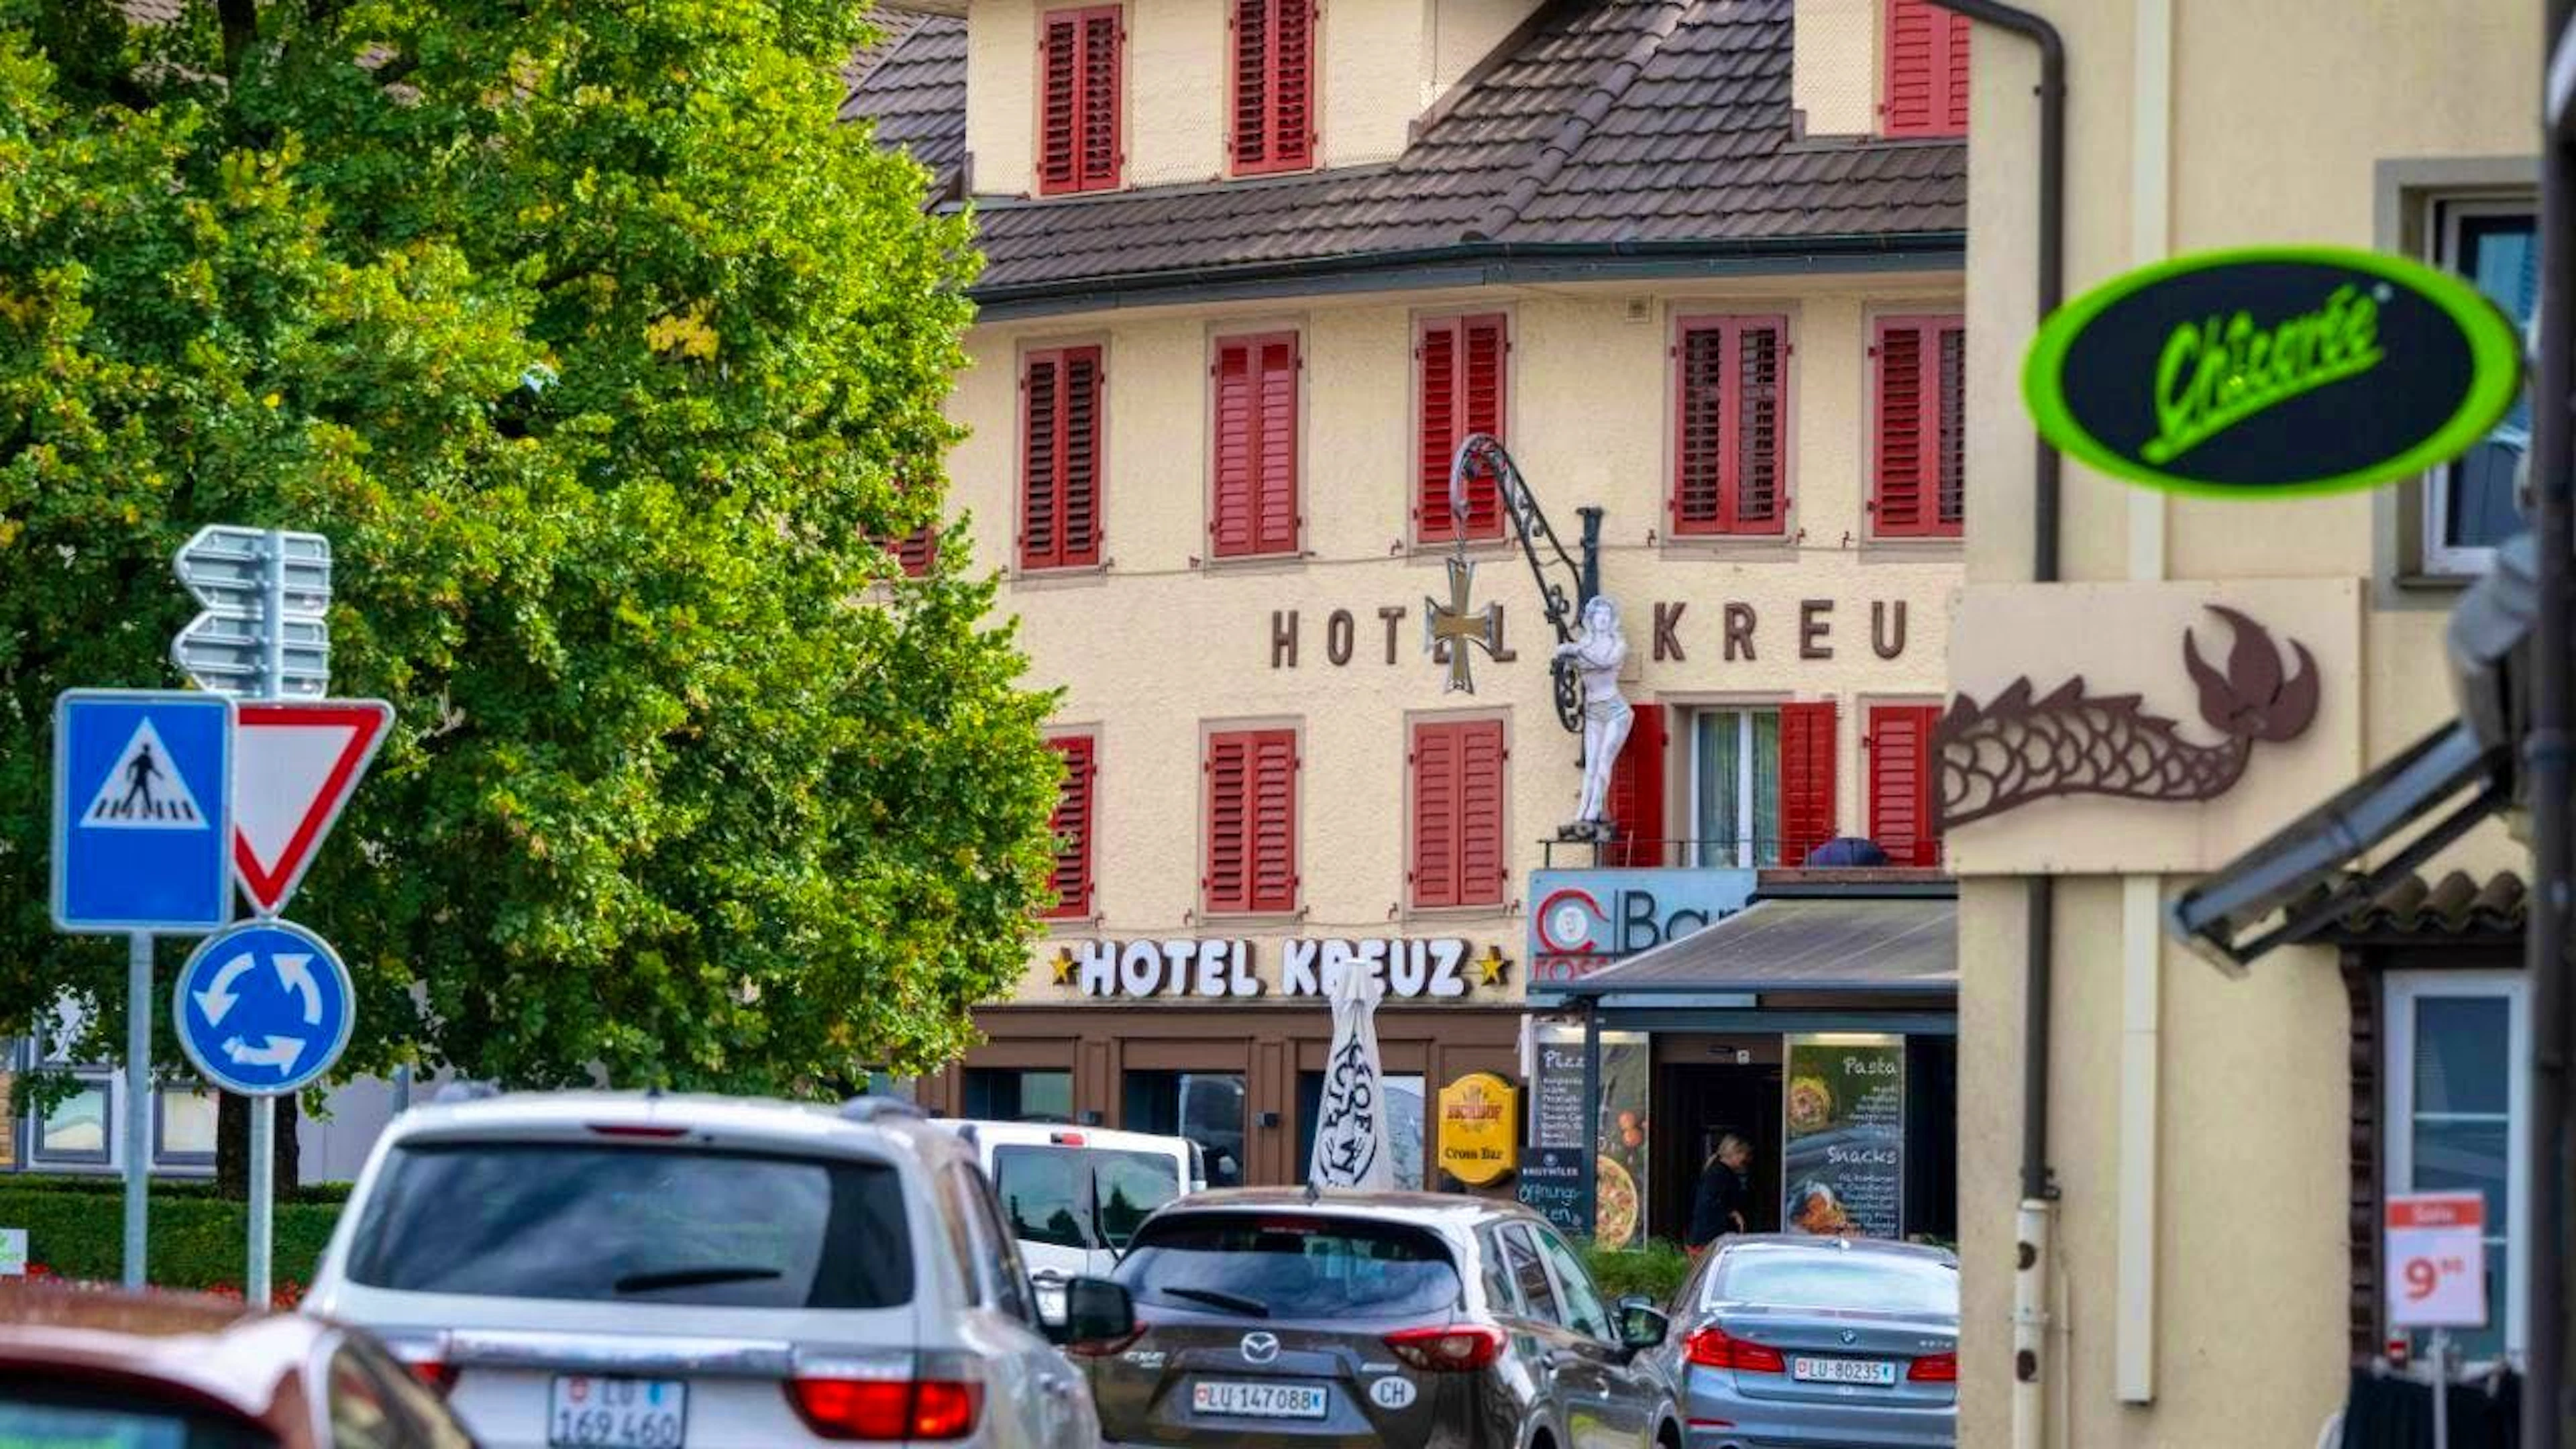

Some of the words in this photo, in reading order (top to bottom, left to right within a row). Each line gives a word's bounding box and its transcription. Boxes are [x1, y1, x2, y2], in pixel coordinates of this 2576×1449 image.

[1272, 604, 1517, 668] HOTL
[1081, 939, 1263, 998] HOTEL
[1281, 939, 1465, 998] KREUZ
[1843, 1055, 1897, 1075] Pasta
[1481, 1147, 1503, 1160] Bar
[1826, 1144, 1898, 1165] Snacks
[602, 1379, 636, 1406] LU
[1209, 1386, 1232, 1407] LU
[1380, 1382, 1405, 1403] CH
[559, 1409, 613, 1444] 169
[621, 1411, 678, 1446] 460
